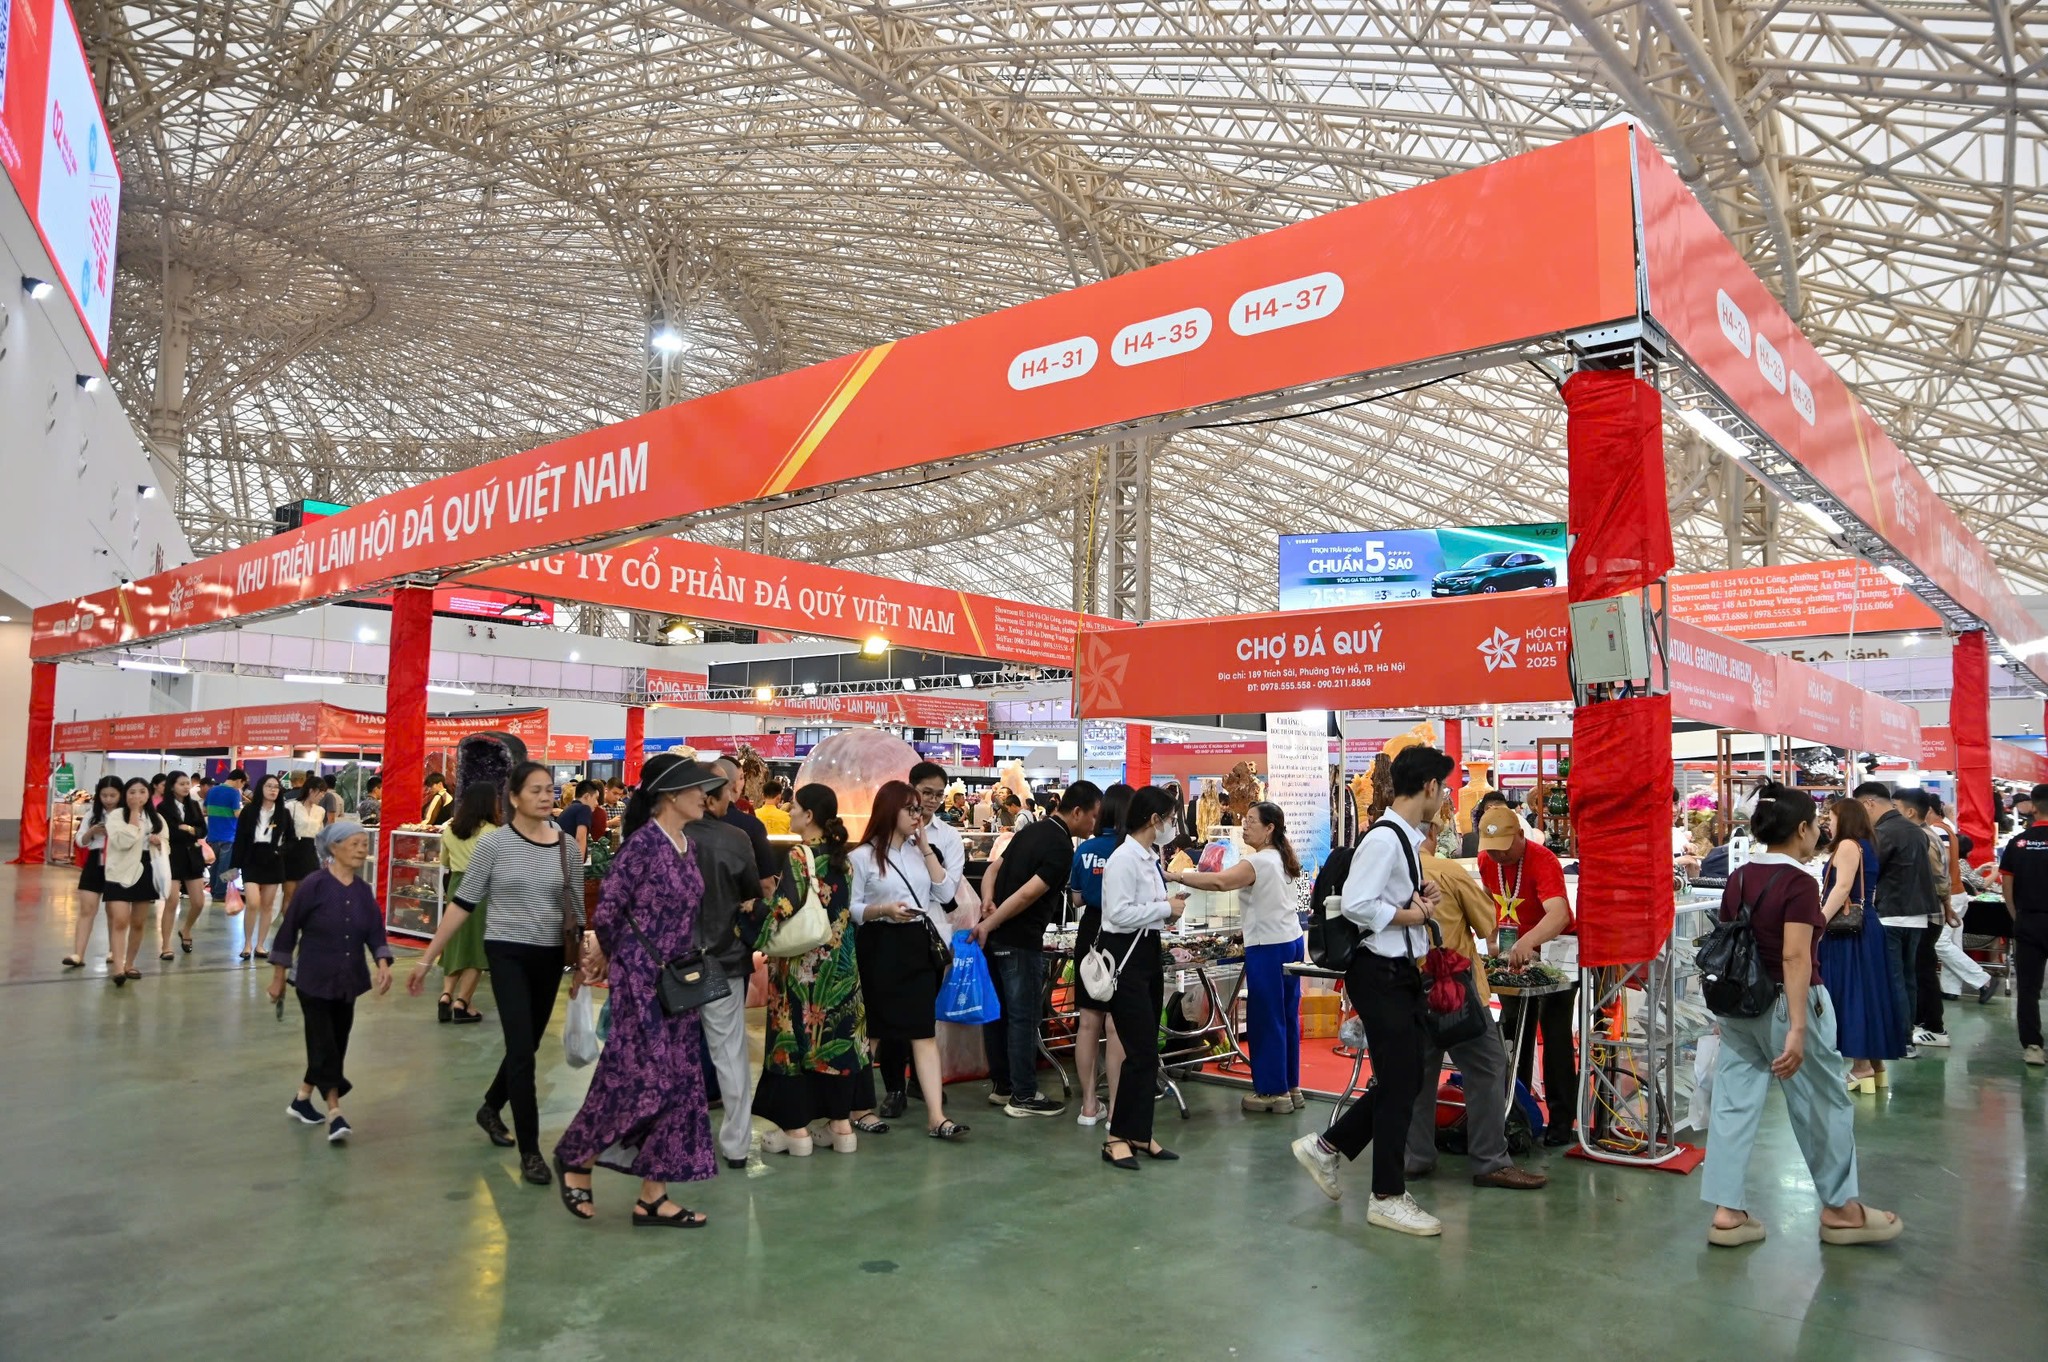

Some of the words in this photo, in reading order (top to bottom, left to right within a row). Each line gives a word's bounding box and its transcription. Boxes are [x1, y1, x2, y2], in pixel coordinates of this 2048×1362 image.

[1245, 285, 1328, 324] H4-37
[1722, 302, 1746, 345] H4-21
[1124, 320, 1198, 355] H4-35
[1022, 348, 1083, 379] H4-31
[1760, 344, 1782, 383] H4-23
[1792, 383, 1812, 415] H4-29
[236, 556, 270, 596] KHU
[272, 530, 316, 586] TRIỂN
[318, 526, 356, 573] LÃM
[359, 508, 397, 562] HỘI
[402, 495, 435, 550] ĐÁ
[442, 476, 500, 542] QUÝ
[506, 461, 567, 524] VIỆT
[573, 441, 649, 509] NAM
[1308, 554, 1363, 574] CHUẨN
[1365, 541, 1385, 574] 5
[1388, 557, 1413, 570] SAO
[575, 553, 614, 583] TY
[621, 547, 661, 591] CỔ
[669, 557, 746, 607] PHẦN
[754, 576, 792, 611] ĐÁ
[799, 585, 846, 620] QUÝ
[852, 594, 902, 631] VIỆT
[907, 605, 955, 635] NAM
[1672, 582, 1709, 592] Showroom
[1711, 580, 1722, 589] 01:
[1724, 579, 1737, 588] 134
[1750, 575, 1764, 585] Chí
[1672, 593, 1709, 603] Showroom
[1712, 591, 1722, 600] 02:
[1724, 588, 1752, 599] 107-109
[1755, 587, 1765, 595] An
[1820, 581, 1832, 591] An
[995, 606, 1018, 616] Showroom
[1672, 604, 1687, 613] Kho
[1722, 599, 1735, 609] 148
[1736, 598, 1747, 607] An
[1703, 611, 1748, 623] 0906.73.6886
[1754, 607, 1801, 619] 0978.5555.58
[1808, 604, 1841, 615] Hotline:
[995, 615, 1018, 626] Showroom
[1236, 632, 1287, 666] CHỢ
[1293, 626, 1326, 657] ĐÁ
[1333, 621, 1383, 656] QUÝ
[1526, 626, 1547, 641] HỘI
[1549, 626, 1568, 637] CH
[1526, 640, 1553, 653] MÙA
[1218, 672, 1231, 681] Địa
[1248, 671, 1262, 679] 189
[1263, 668, 1281, 678] Trích
[1299, 666, 1330, 679] Phường
[1331, 665, 1346, 676] Tây
[1364, 664, 1374, 673] TP.
[1377, 662, 1389, 672] Hà
[1391, 661, 1405, 673] Nội
[1526, 656, 1557, 668] 2025
[1695, 646, 1728, 677] GEMSTONE
[648, 676, 680, 693] CÔNG
[1247, 683, 1259, 692] ĐT:
[1260, 681, 1311, 691] 0978.555.558
[1317, 678, 1371, 689] 090.211.8868
[847, 701, 863, 714] LAN
[1081, 852, 1106, 870] Via
